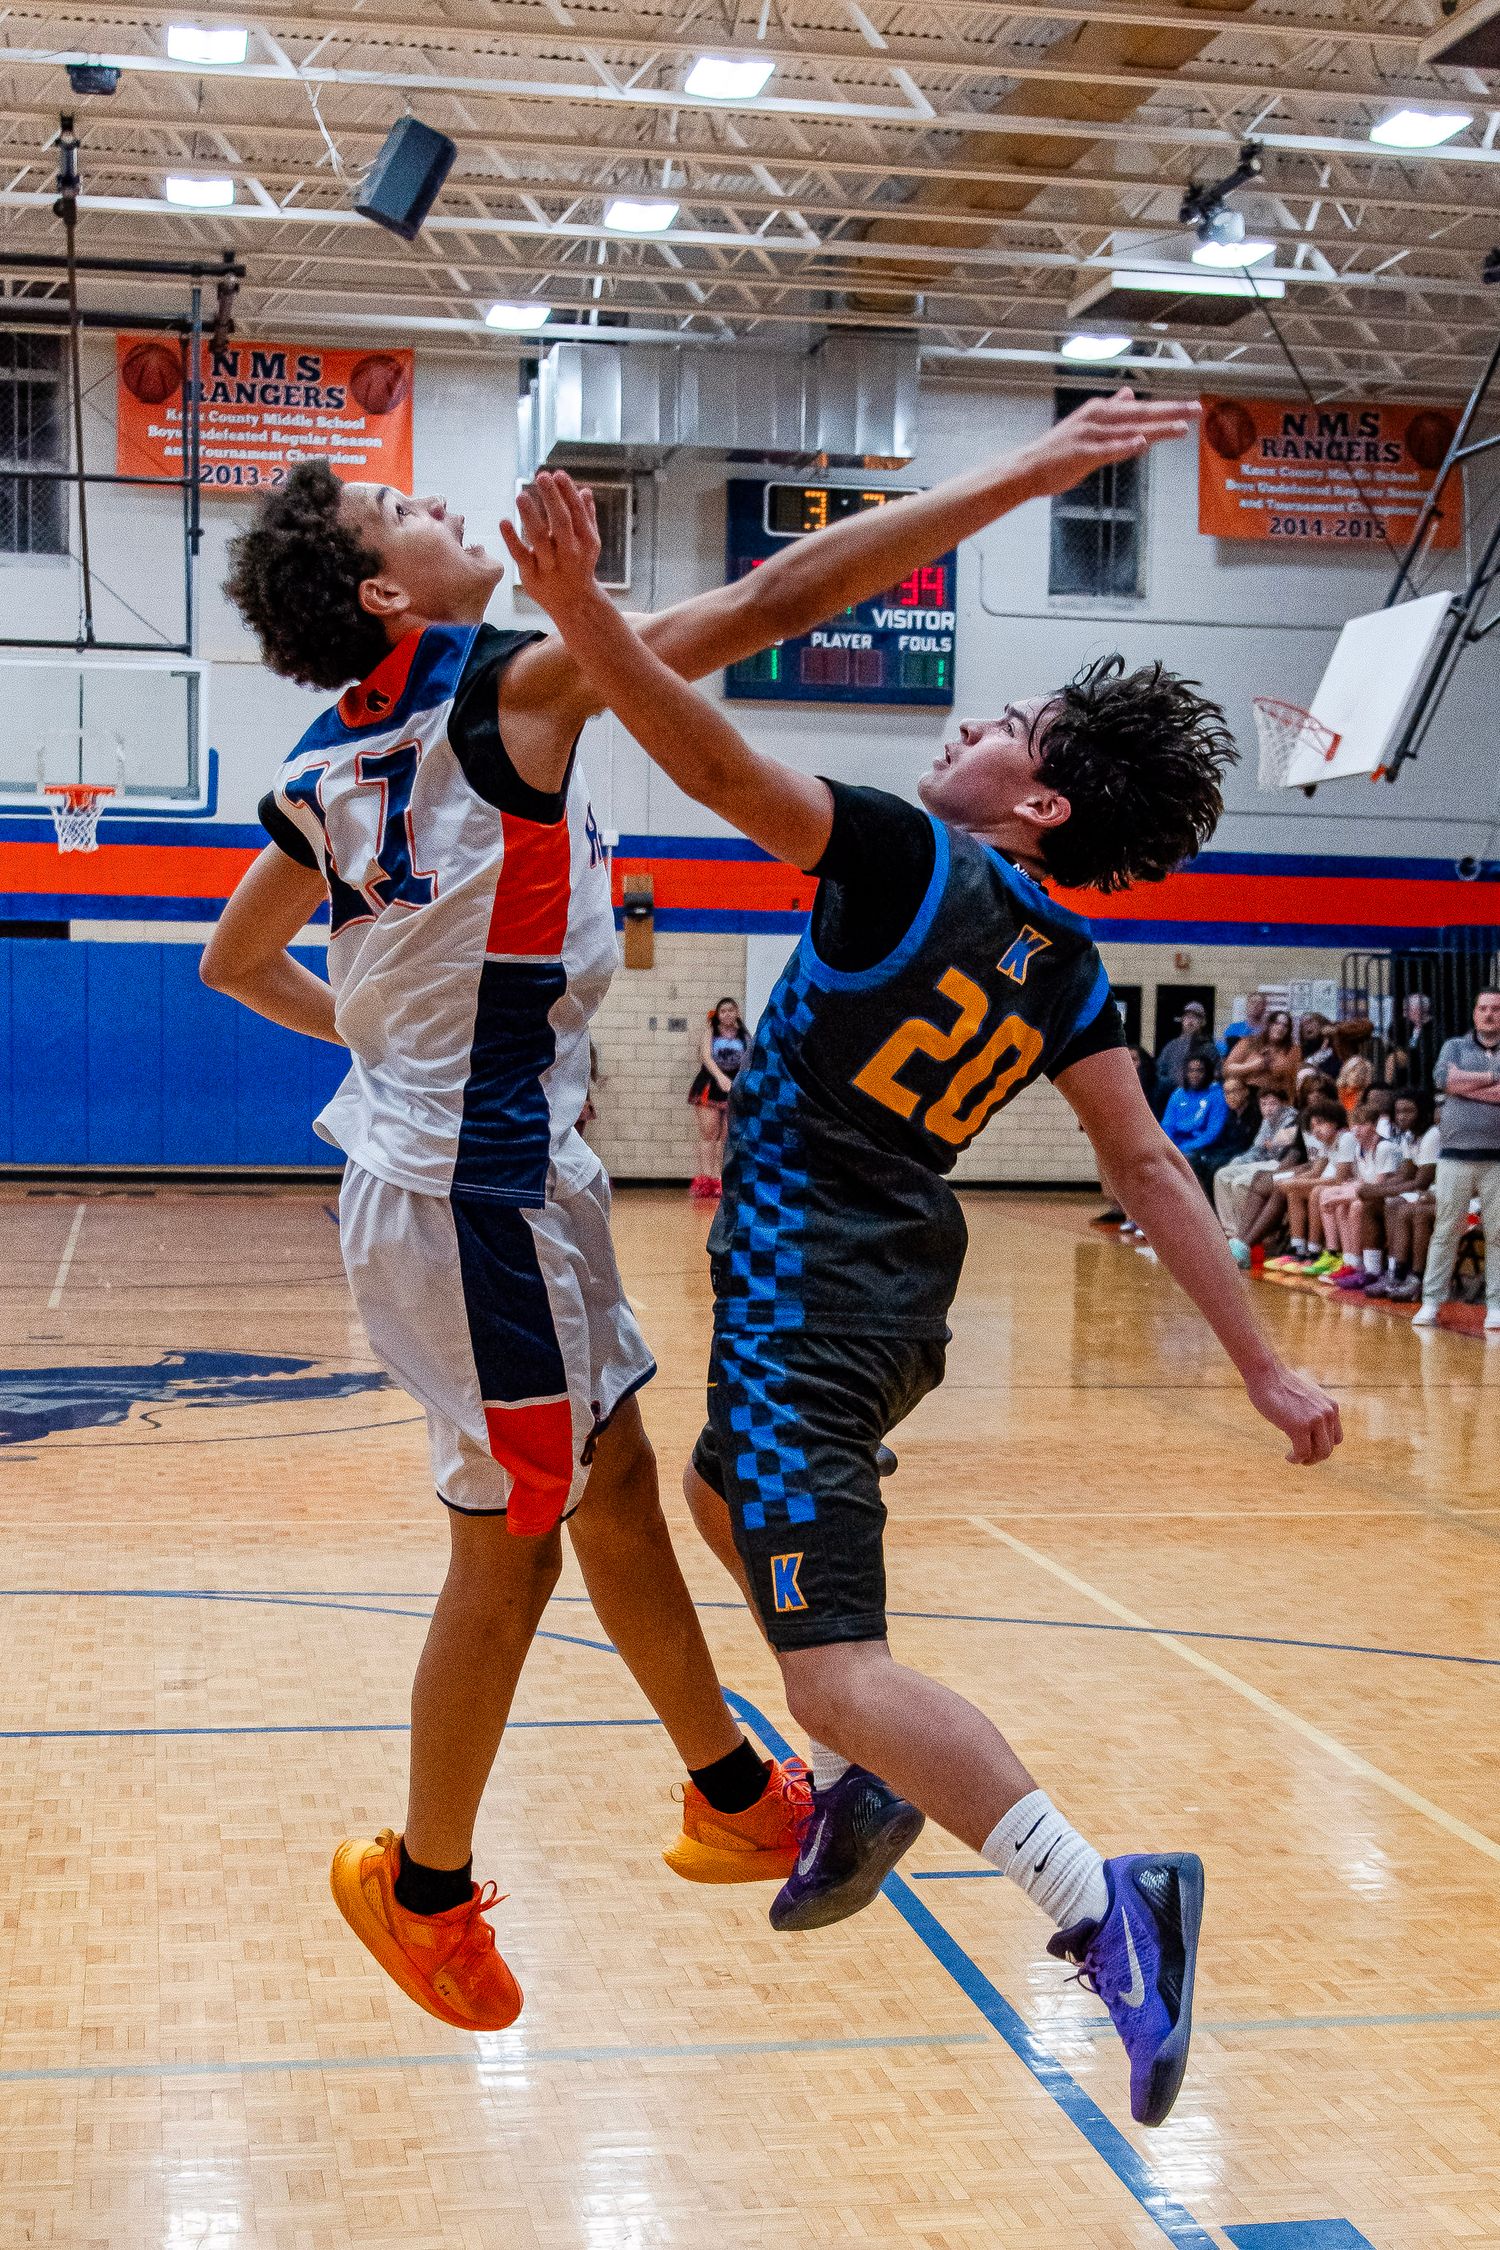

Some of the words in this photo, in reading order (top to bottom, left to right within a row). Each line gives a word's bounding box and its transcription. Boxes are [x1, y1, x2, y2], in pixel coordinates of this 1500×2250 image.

[1261, 438, 1400, 462] RANGERS
[872, 608, 956, 631] VISITOR
[811, 632, 872, 649] PLAYER
[898, 635, 953, 652] FOULS
[996, 924, 1053, 985] K
[851, 965, 1044, 1145] 20
[770, 1552, 809, 1612] K
